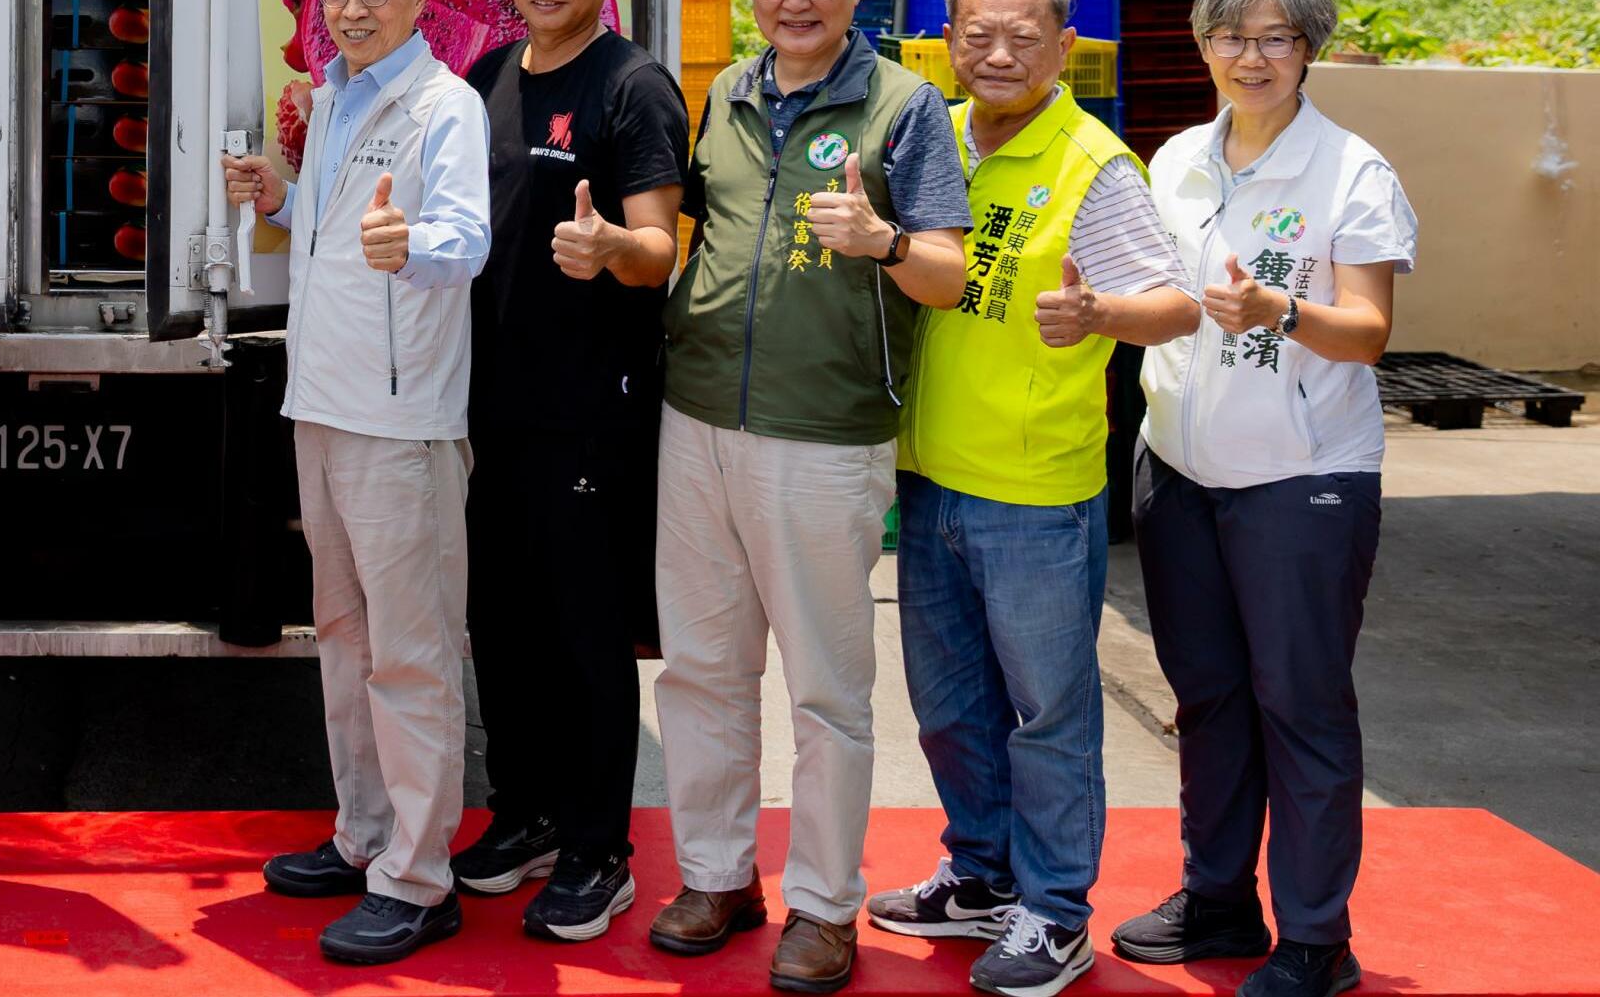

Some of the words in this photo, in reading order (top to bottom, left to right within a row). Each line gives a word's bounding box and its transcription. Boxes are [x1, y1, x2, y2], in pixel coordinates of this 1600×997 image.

[549, 149, 576, 163] DREAM
[787, 191, 814, 273] 徐富癸
[955, 202, 1014, 317] 潘芳泉
[983, 210, 1039, 324] 屏東縣議員
[1242, 248, 1296, 374] 鍾濱
